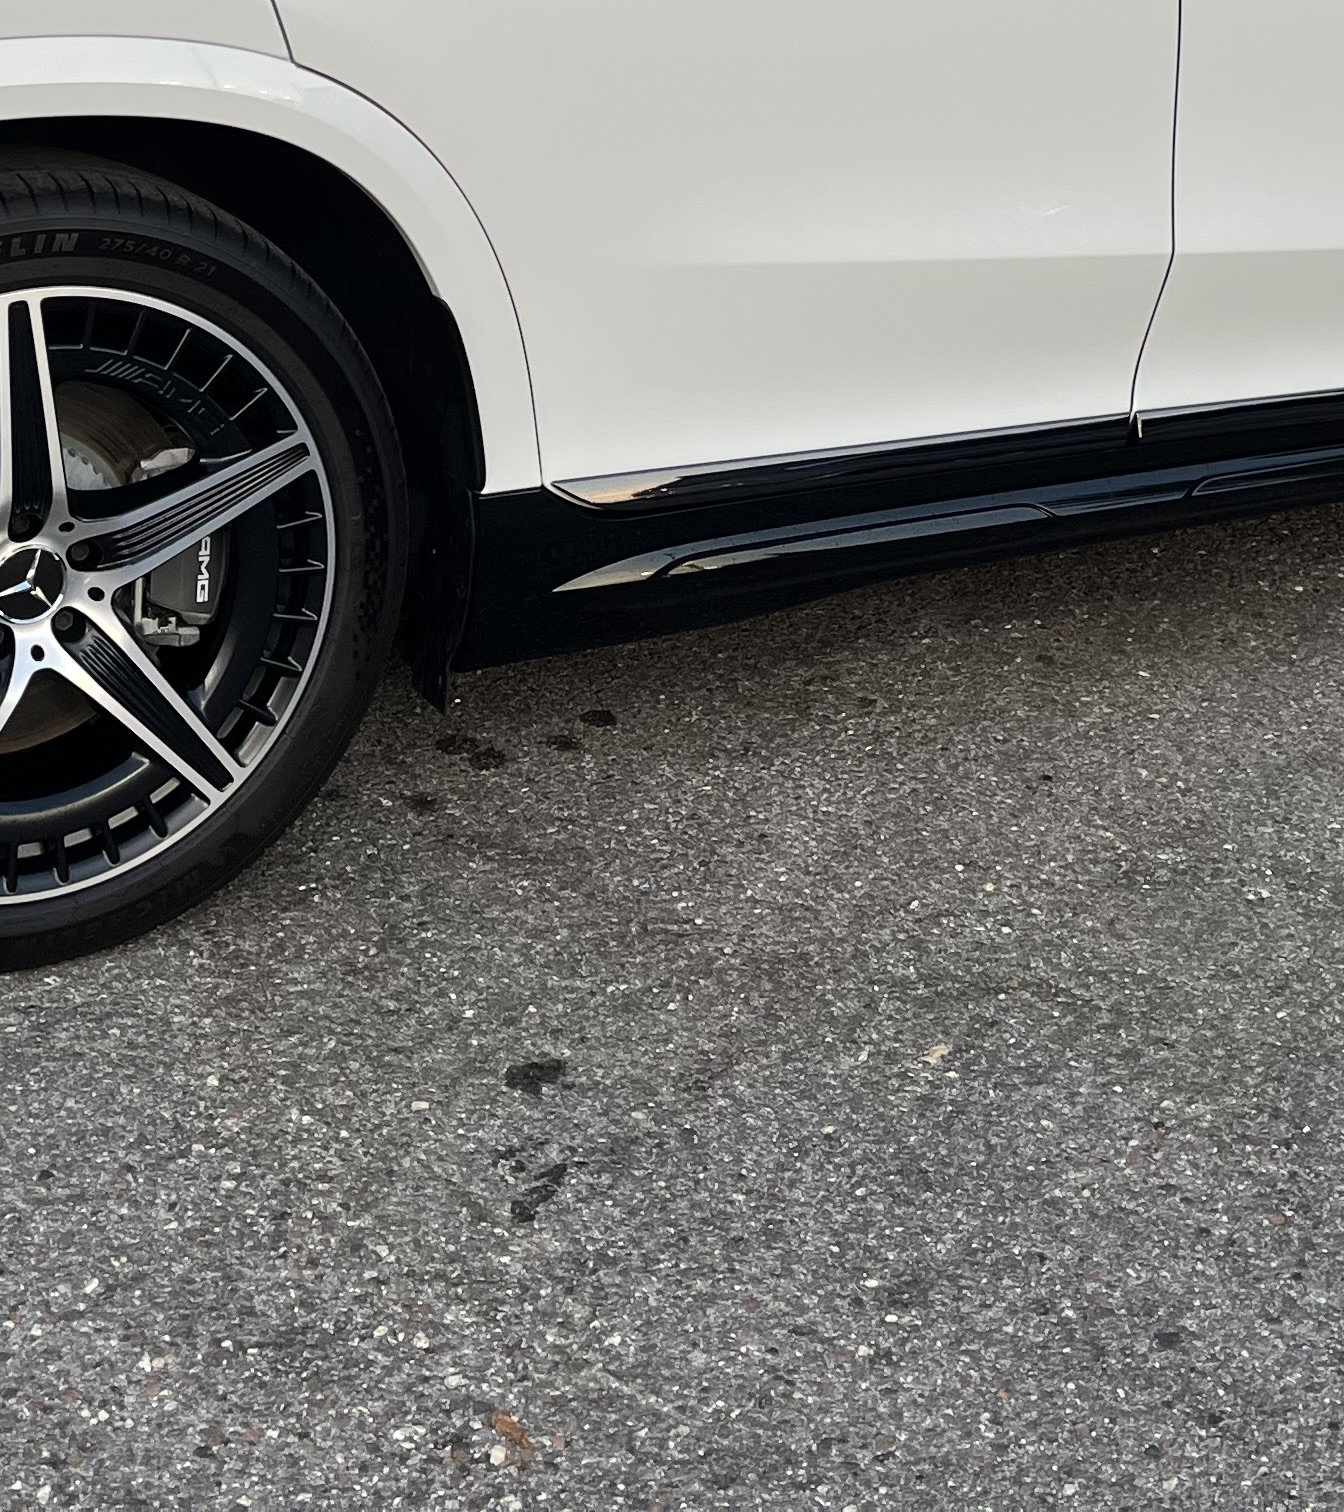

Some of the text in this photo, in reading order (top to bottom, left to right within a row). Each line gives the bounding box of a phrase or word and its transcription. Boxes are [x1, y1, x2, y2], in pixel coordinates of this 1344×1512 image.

[98, 236, 173, 263] 275/40
[176, 251, 190, 268] R
[196, 259, 218, 280] 21
[196, 535, 212, 603] AMG
